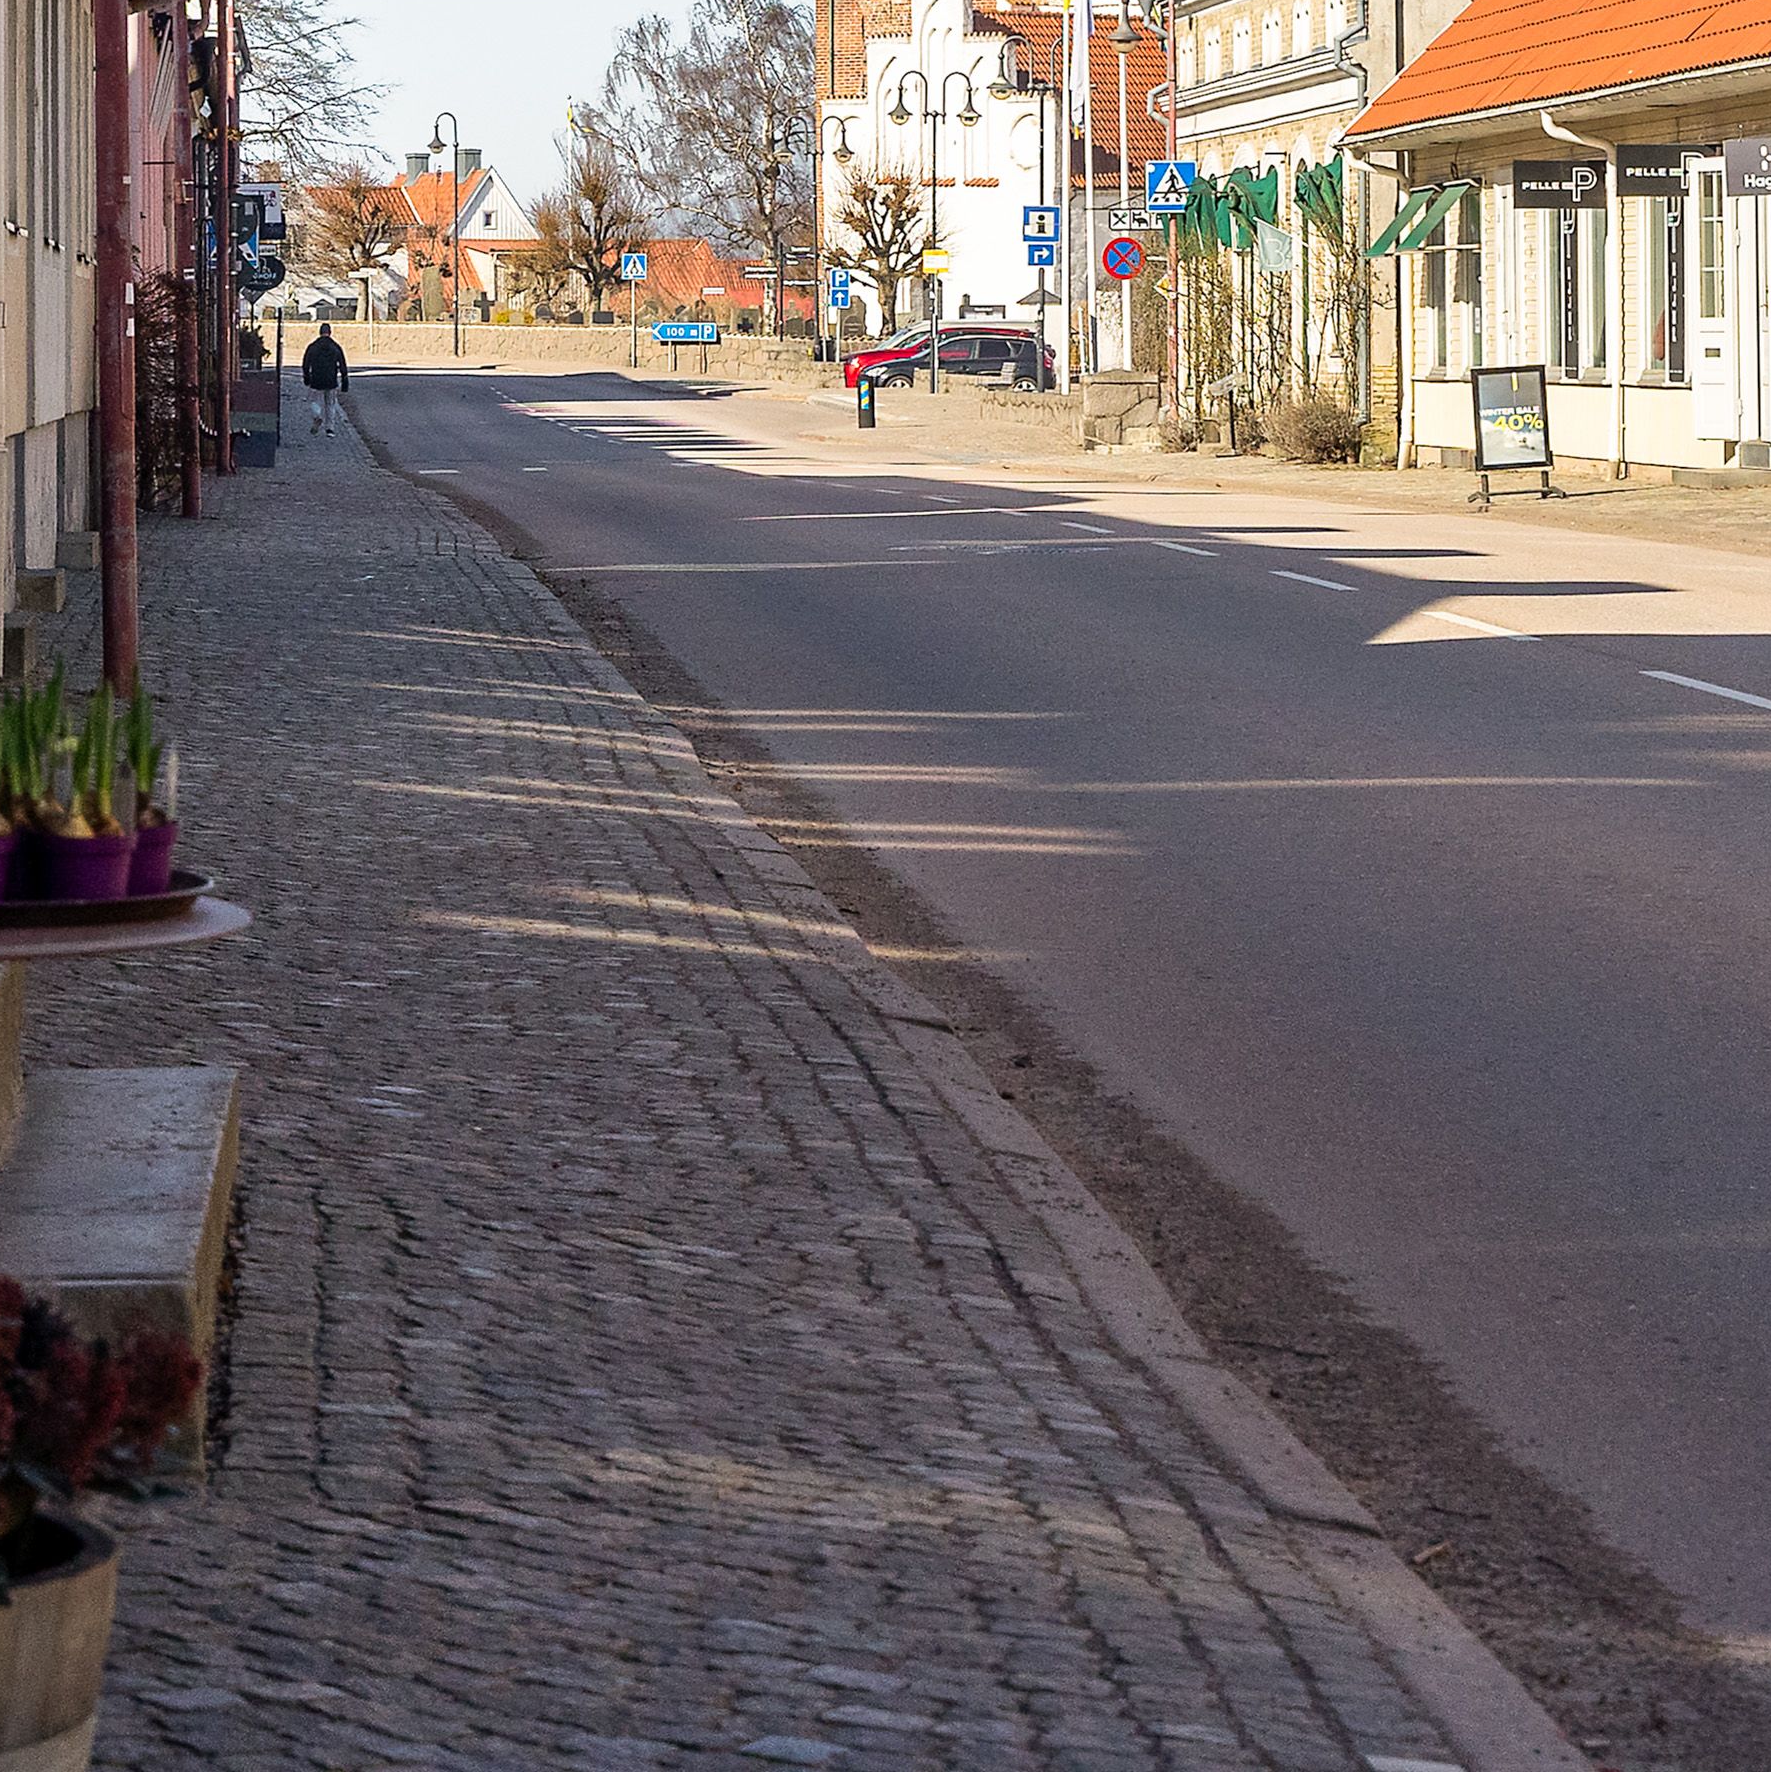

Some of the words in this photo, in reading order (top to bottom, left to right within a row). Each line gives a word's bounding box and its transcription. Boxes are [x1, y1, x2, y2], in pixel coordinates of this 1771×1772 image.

[1626, 167, 1667, 177] PELLE
[1521, 181, 1560, 190] PELLE
[1572, 166, 1597, 202] P
[834, 271, 847, 287] P
[666, 327, 685, 337] 100
[703, 325, 713, 339] P
[1515, 405, 1540, 415] SALE
[1493, 413, 1545, 432] 40%
